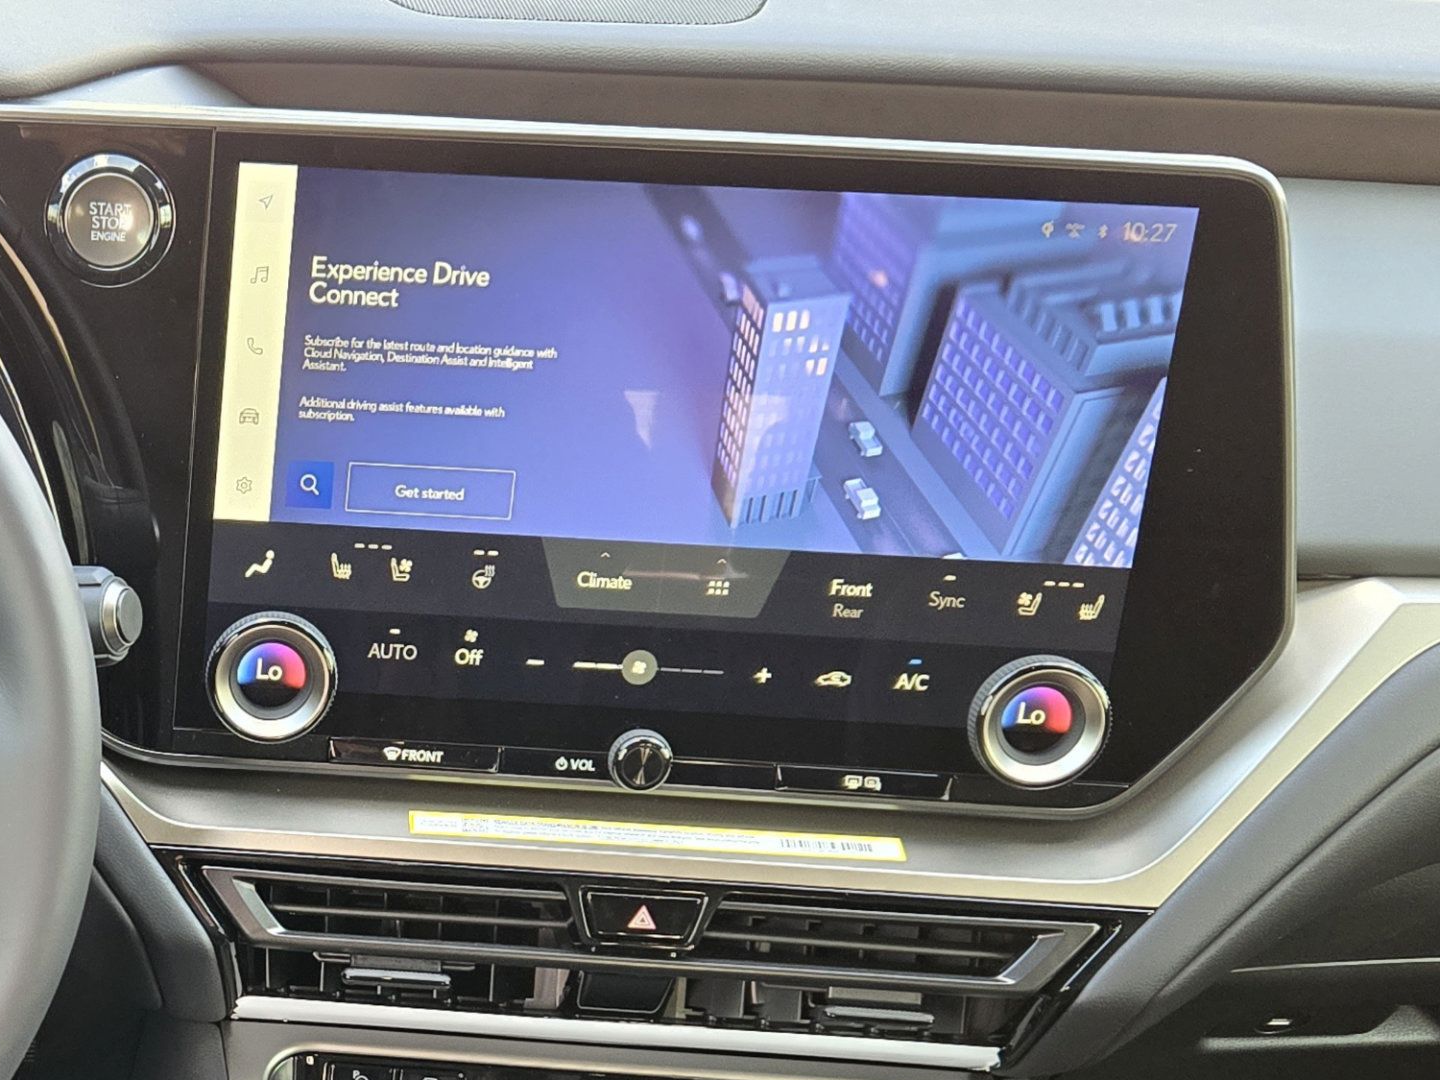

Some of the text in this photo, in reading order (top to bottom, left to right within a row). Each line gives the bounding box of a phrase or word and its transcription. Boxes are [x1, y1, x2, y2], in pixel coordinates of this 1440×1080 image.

[89, 201, 132, 216] START
[90, 230, 127, 242] ENGINE
[1122, 221, 1178, 243] 10:27
[310, 255, 491, 288] Experience Drive
[309, 281, 400, 308] Connect
[304, 334, 558, 359] Subscribe for the latest route and location guidance with
[302, 360, 347, 372] Assistant.
[303, 347, 534, 371] Cloud Navigation, Destination Assist and Intelligent
[298, 408, 355, 422] subscription.
[299, 396, 505, 418] Additional driving assist features available with
[394, 484, 465, 501] Get started
[576, 570, 633, 592] Climate
[828, 578, 874, 598] Front
[927, 590, 966, 610] Sync
[832, 603, 864, 620] Rear
[367, 642, 418, 662] AUTO
[454, 647, 484, 667] Off
[255, 656, 283, 683] Lo
[892, 672, 931, 692] A/C
[1016, 701, 1046, 727] Lo
[401, 748, 444, 765] FRONT
[569, 757, 596, 772] VOL
